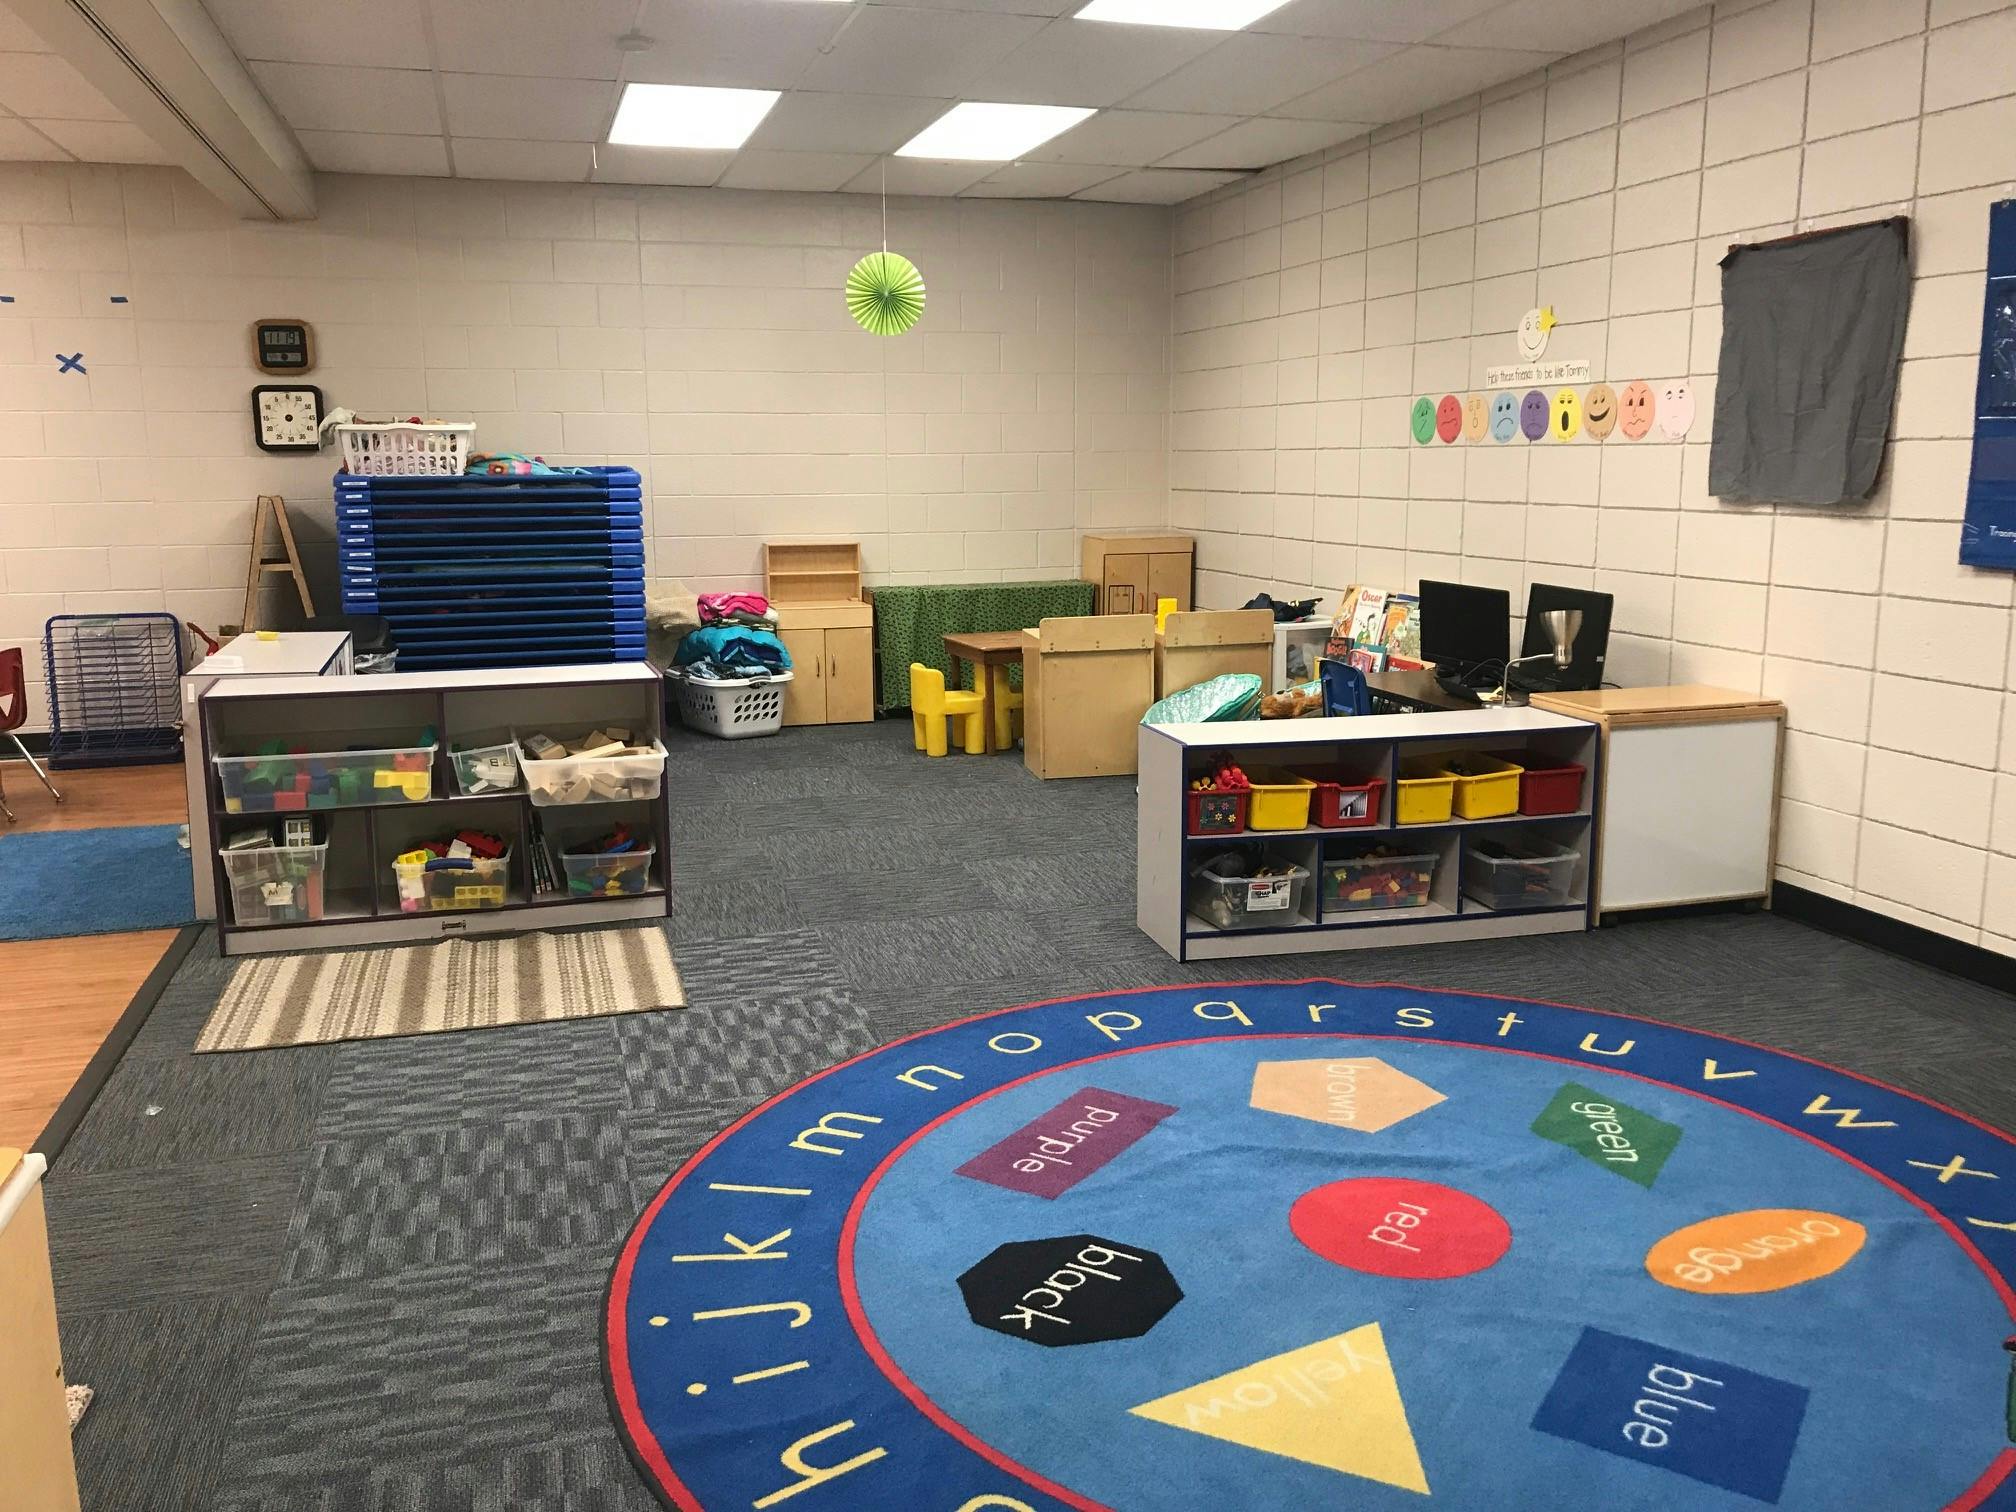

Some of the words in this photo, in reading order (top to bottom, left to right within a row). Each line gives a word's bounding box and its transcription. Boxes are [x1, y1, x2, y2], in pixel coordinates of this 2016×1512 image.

[1536, 368, 1543, 379] to
[1544, 368, 1553, 379] be
[1565, 363, 1590, 381] Tommy
[1361, 590, 1383, 602] Oscar
[1085, 1011, 1142, 1042] p
[1192, 1000, 1254, 1026] q
[1307, 1002, 1337, 1023] r
[1394, 1005, 1435, 1029] s
[1497, 1012, 1525, 1037] t
[987, 1031, 1043, 1054] o
[1579, 1031, 1636, 1057] u
[895, 1064, 964, 1091] n
[1703, 1059, 1758, 1081] v
[1326, 1064, 1373, 1121] brown
[1802, 1093, 1899, 1129] w
[788, 1111, 884, 1156] m
[1012, 1105, 1120, 1174] purple
[1570, 1100, 1640, 1164] green
[1906, 1154, 2000, 1184] x
[708, 1182, 812, 1196] l
[1366, 1201, 1430, 1253] red
[671, 1228, 792, 1262] k
[1674, 1219, 1841, 1284] orange
[999, 1243, 1144, 1330] black
[649, 1300, 812, 1329] j
[686, 1360, 810, 1396] i
[1183, 1338, 1384, 1427] yellow
[1622, 1363, 1725, 1449] blue
[752, 1418, 889, 1509] h
